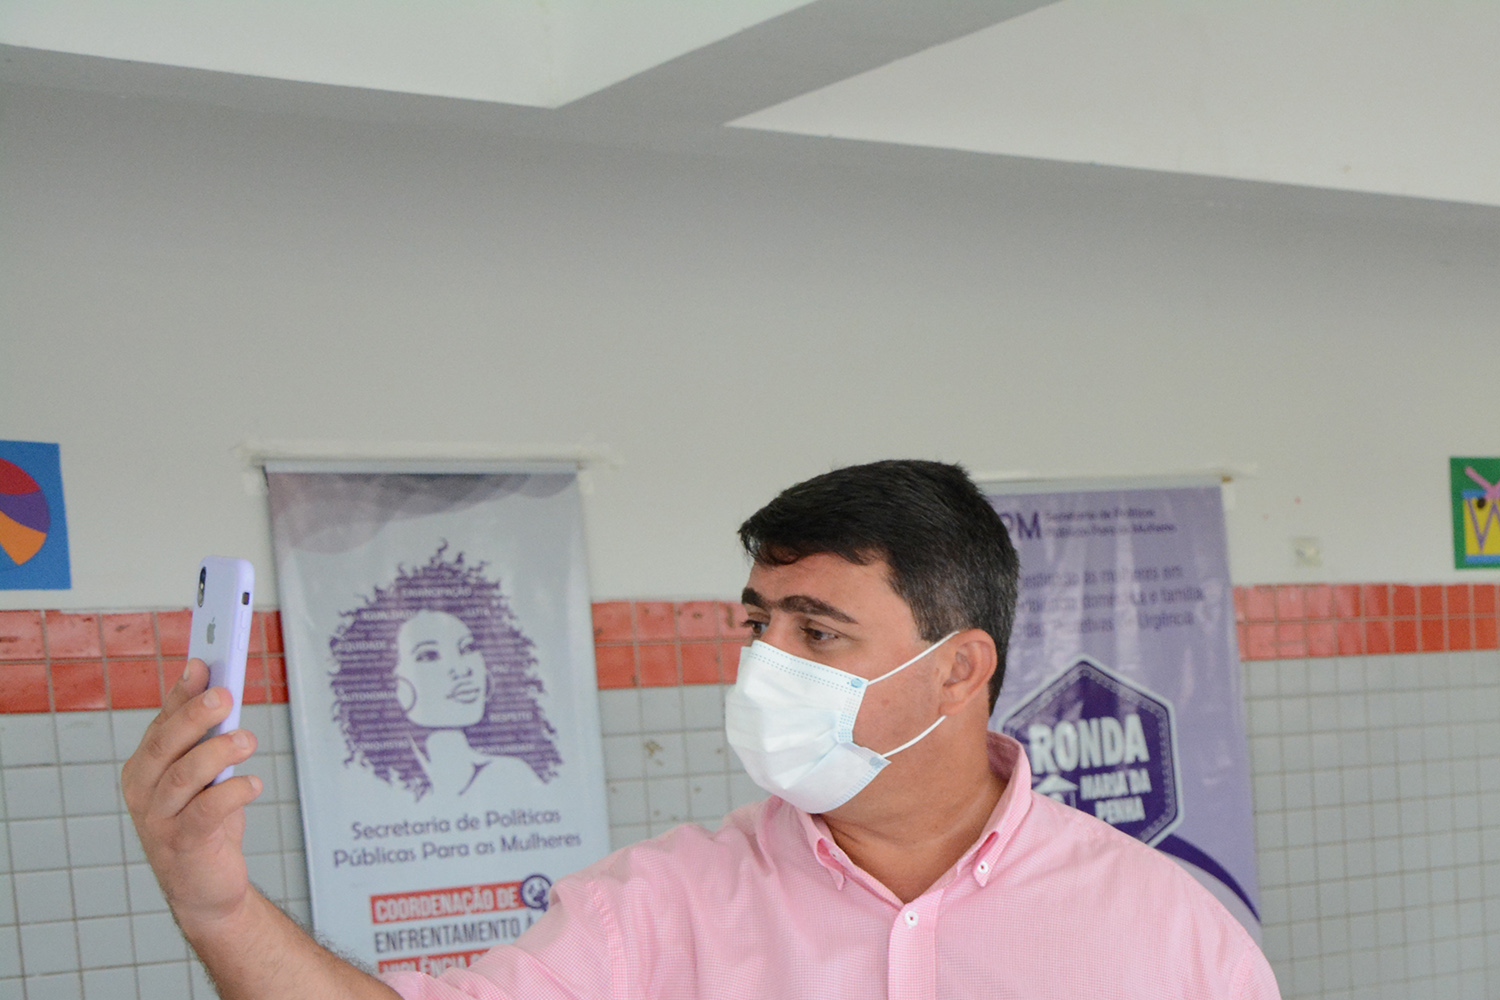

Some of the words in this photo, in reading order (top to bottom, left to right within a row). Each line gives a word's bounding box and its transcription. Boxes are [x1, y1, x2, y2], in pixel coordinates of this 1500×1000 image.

[1028, 713, 1150, 775] RONDA
[1129, 767, 1152, 794] DA
[351, 815, 450, 840] Secretaria
[455, 813, 480, 833] de
[485, 808, 561, 828] Políticas
[333, 846, 417, 869] Públicas
[422, 841, 470, 860] Para
[475, 841, 495, 856] as
[500, 831, 582, 853] Mulheres
[374, 886, 494, 923] COORDENAÇÃO
[496, 885, 519, 909] DE
[374, 917, 520, 954] ENFRENTAMENTO
